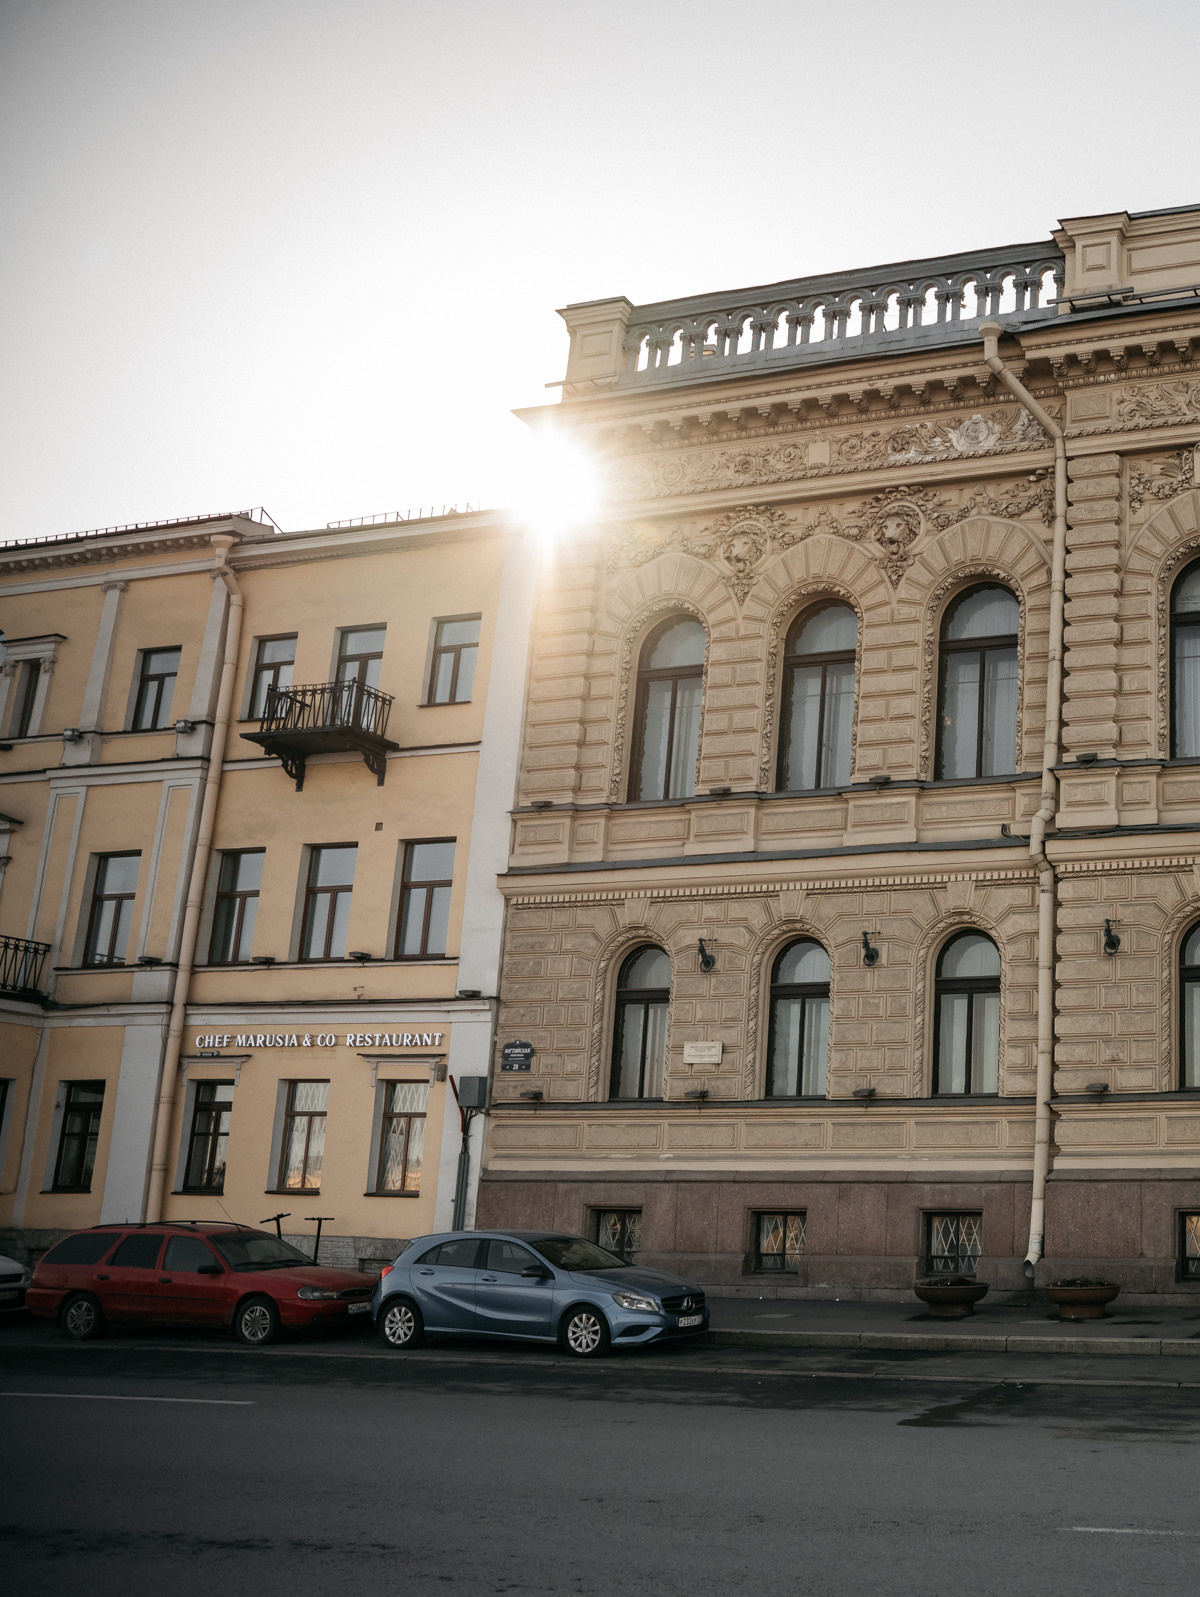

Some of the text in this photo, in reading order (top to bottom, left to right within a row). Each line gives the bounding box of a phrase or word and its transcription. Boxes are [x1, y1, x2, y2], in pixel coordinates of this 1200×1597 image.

[195, 1032, 443, 1048] CHEF MARUSIA & CO RESTAURANT
